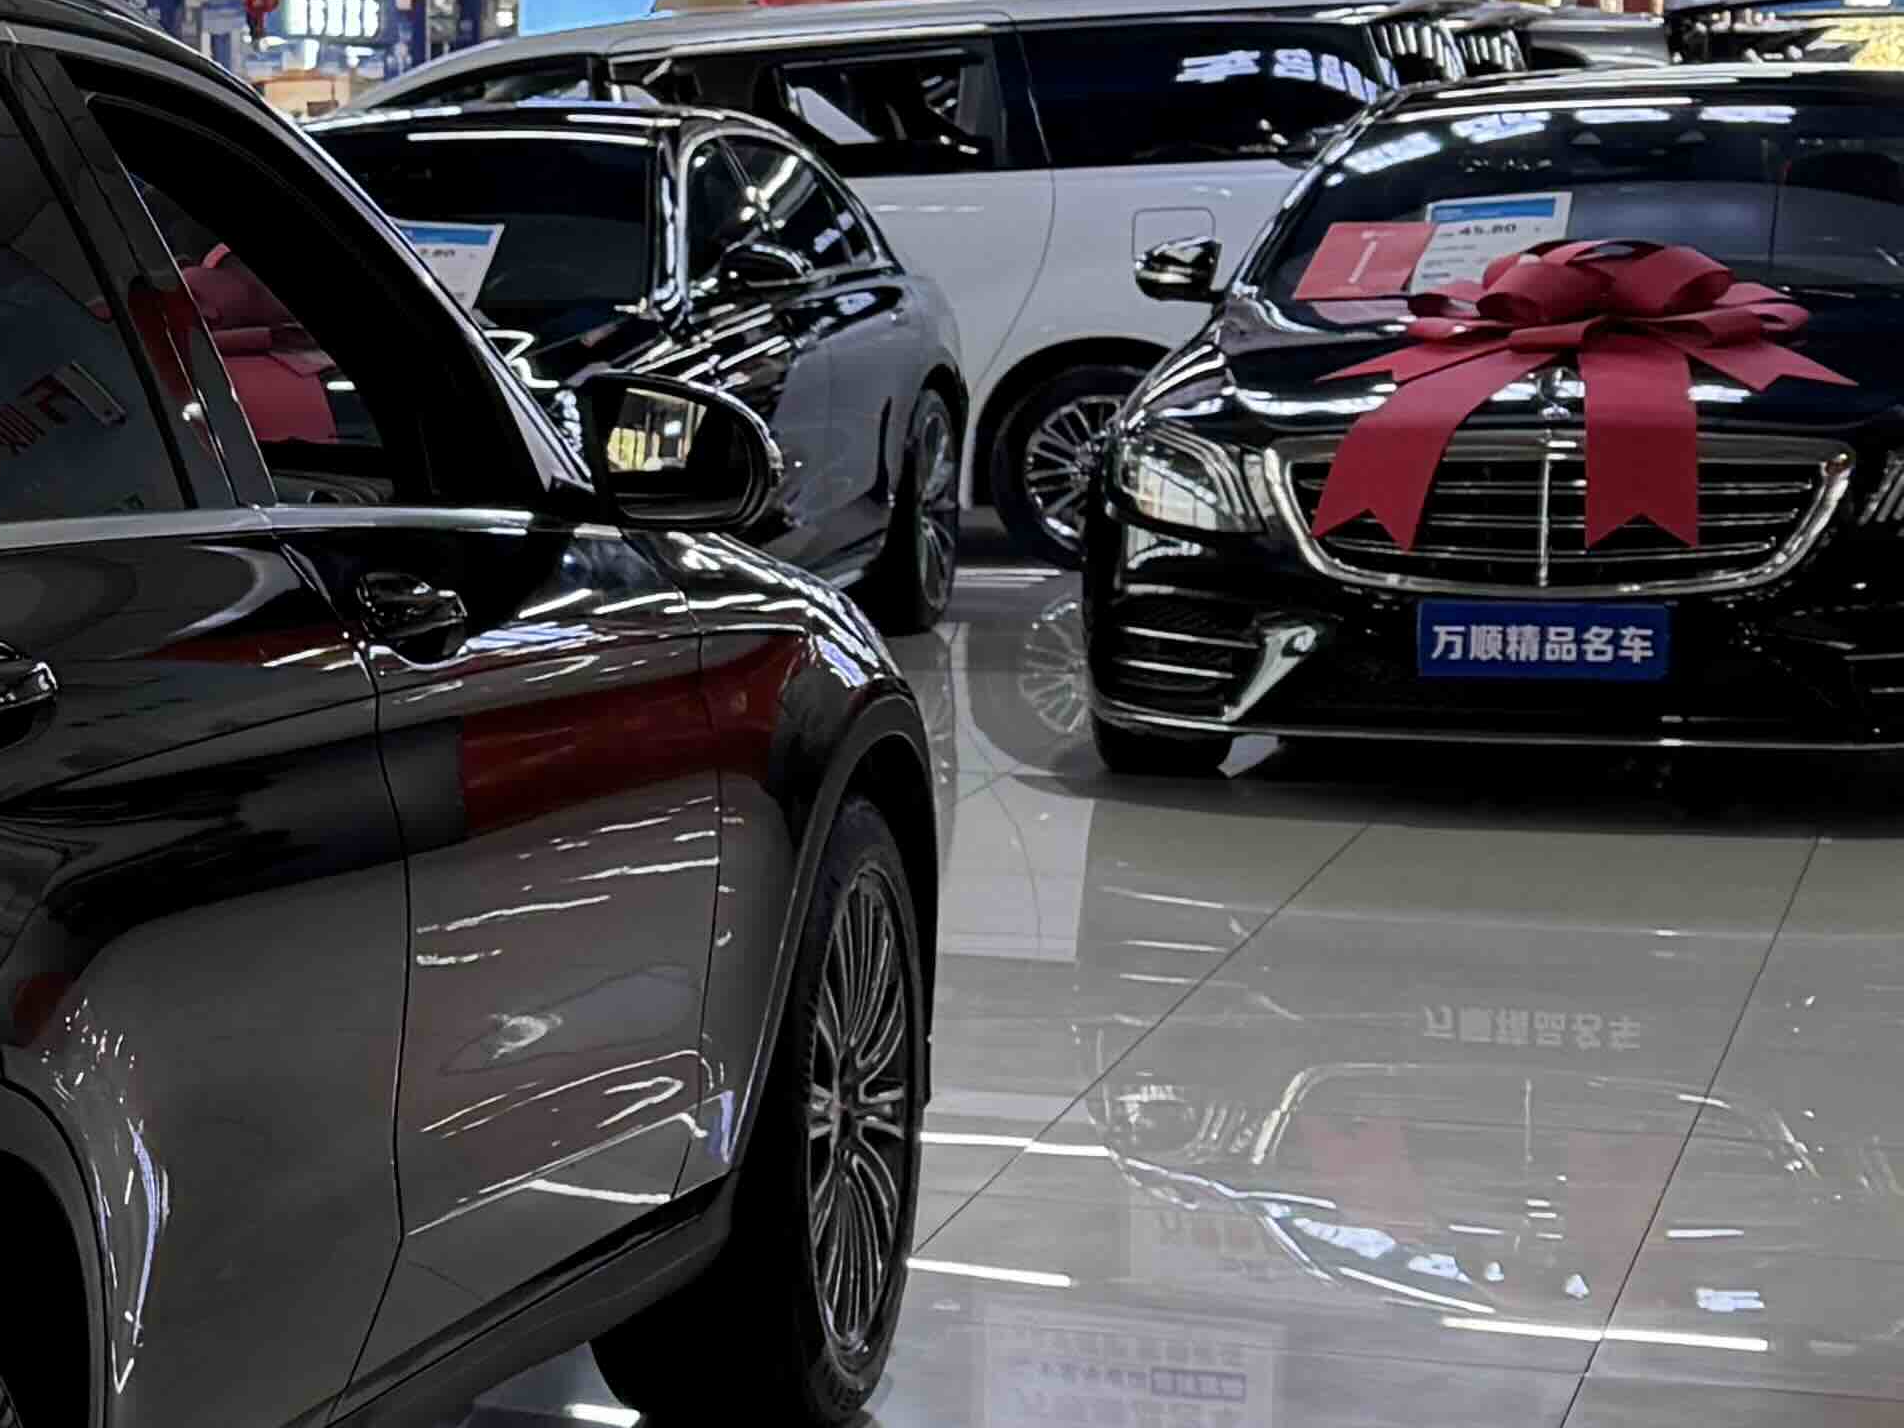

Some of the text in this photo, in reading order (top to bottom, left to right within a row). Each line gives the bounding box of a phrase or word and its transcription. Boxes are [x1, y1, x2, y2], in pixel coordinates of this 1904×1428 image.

[1430, 623, 1654, 666] 万顺精品名车
